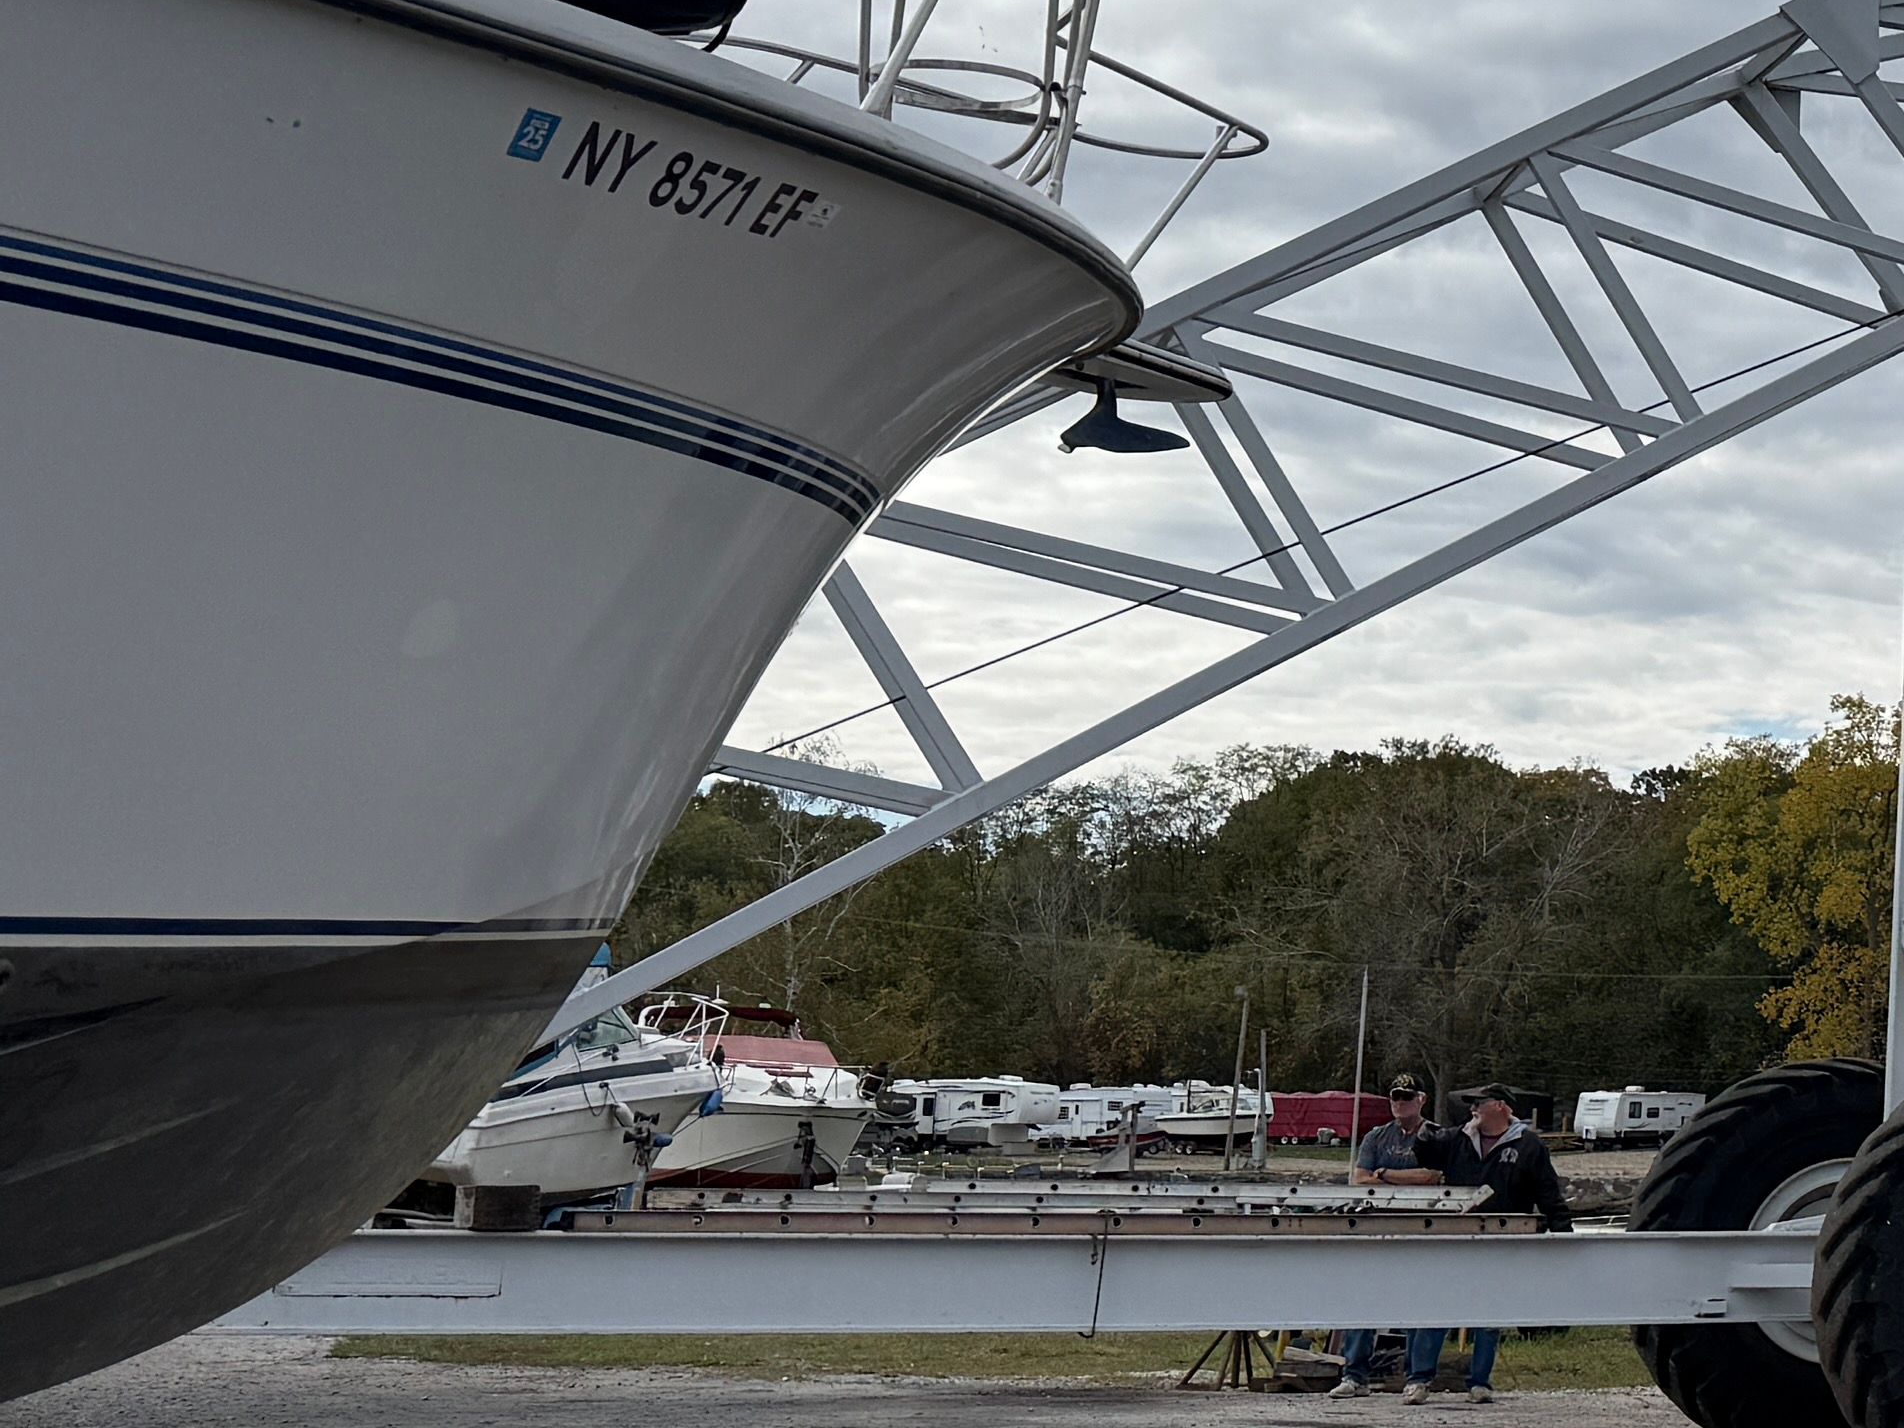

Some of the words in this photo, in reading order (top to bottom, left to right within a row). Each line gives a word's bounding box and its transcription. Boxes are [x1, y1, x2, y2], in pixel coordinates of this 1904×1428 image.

[518, 126, 547, 150] 25
[561, 121, 658, 193] NY
[648, 152, 762, 226] 8571
[748, 183, 819, 238] EF
